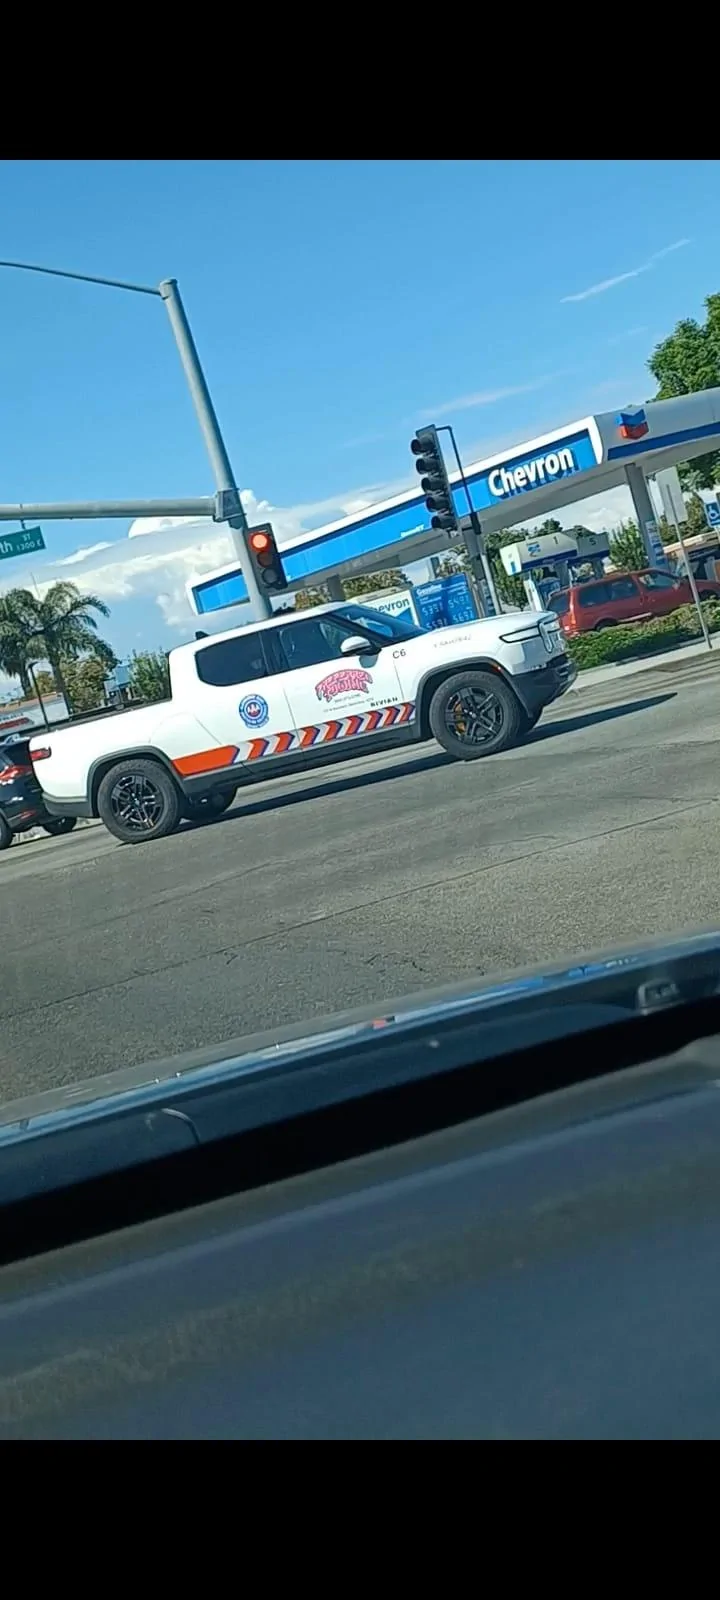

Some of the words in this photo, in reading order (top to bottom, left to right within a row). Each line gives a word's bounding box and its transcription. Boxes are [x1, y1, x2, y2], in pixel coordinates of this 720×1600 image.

[488, 448, 574, 497] Chevron
[376, 598, 410, 613] evron
[392, 649, 406, 659] C6
